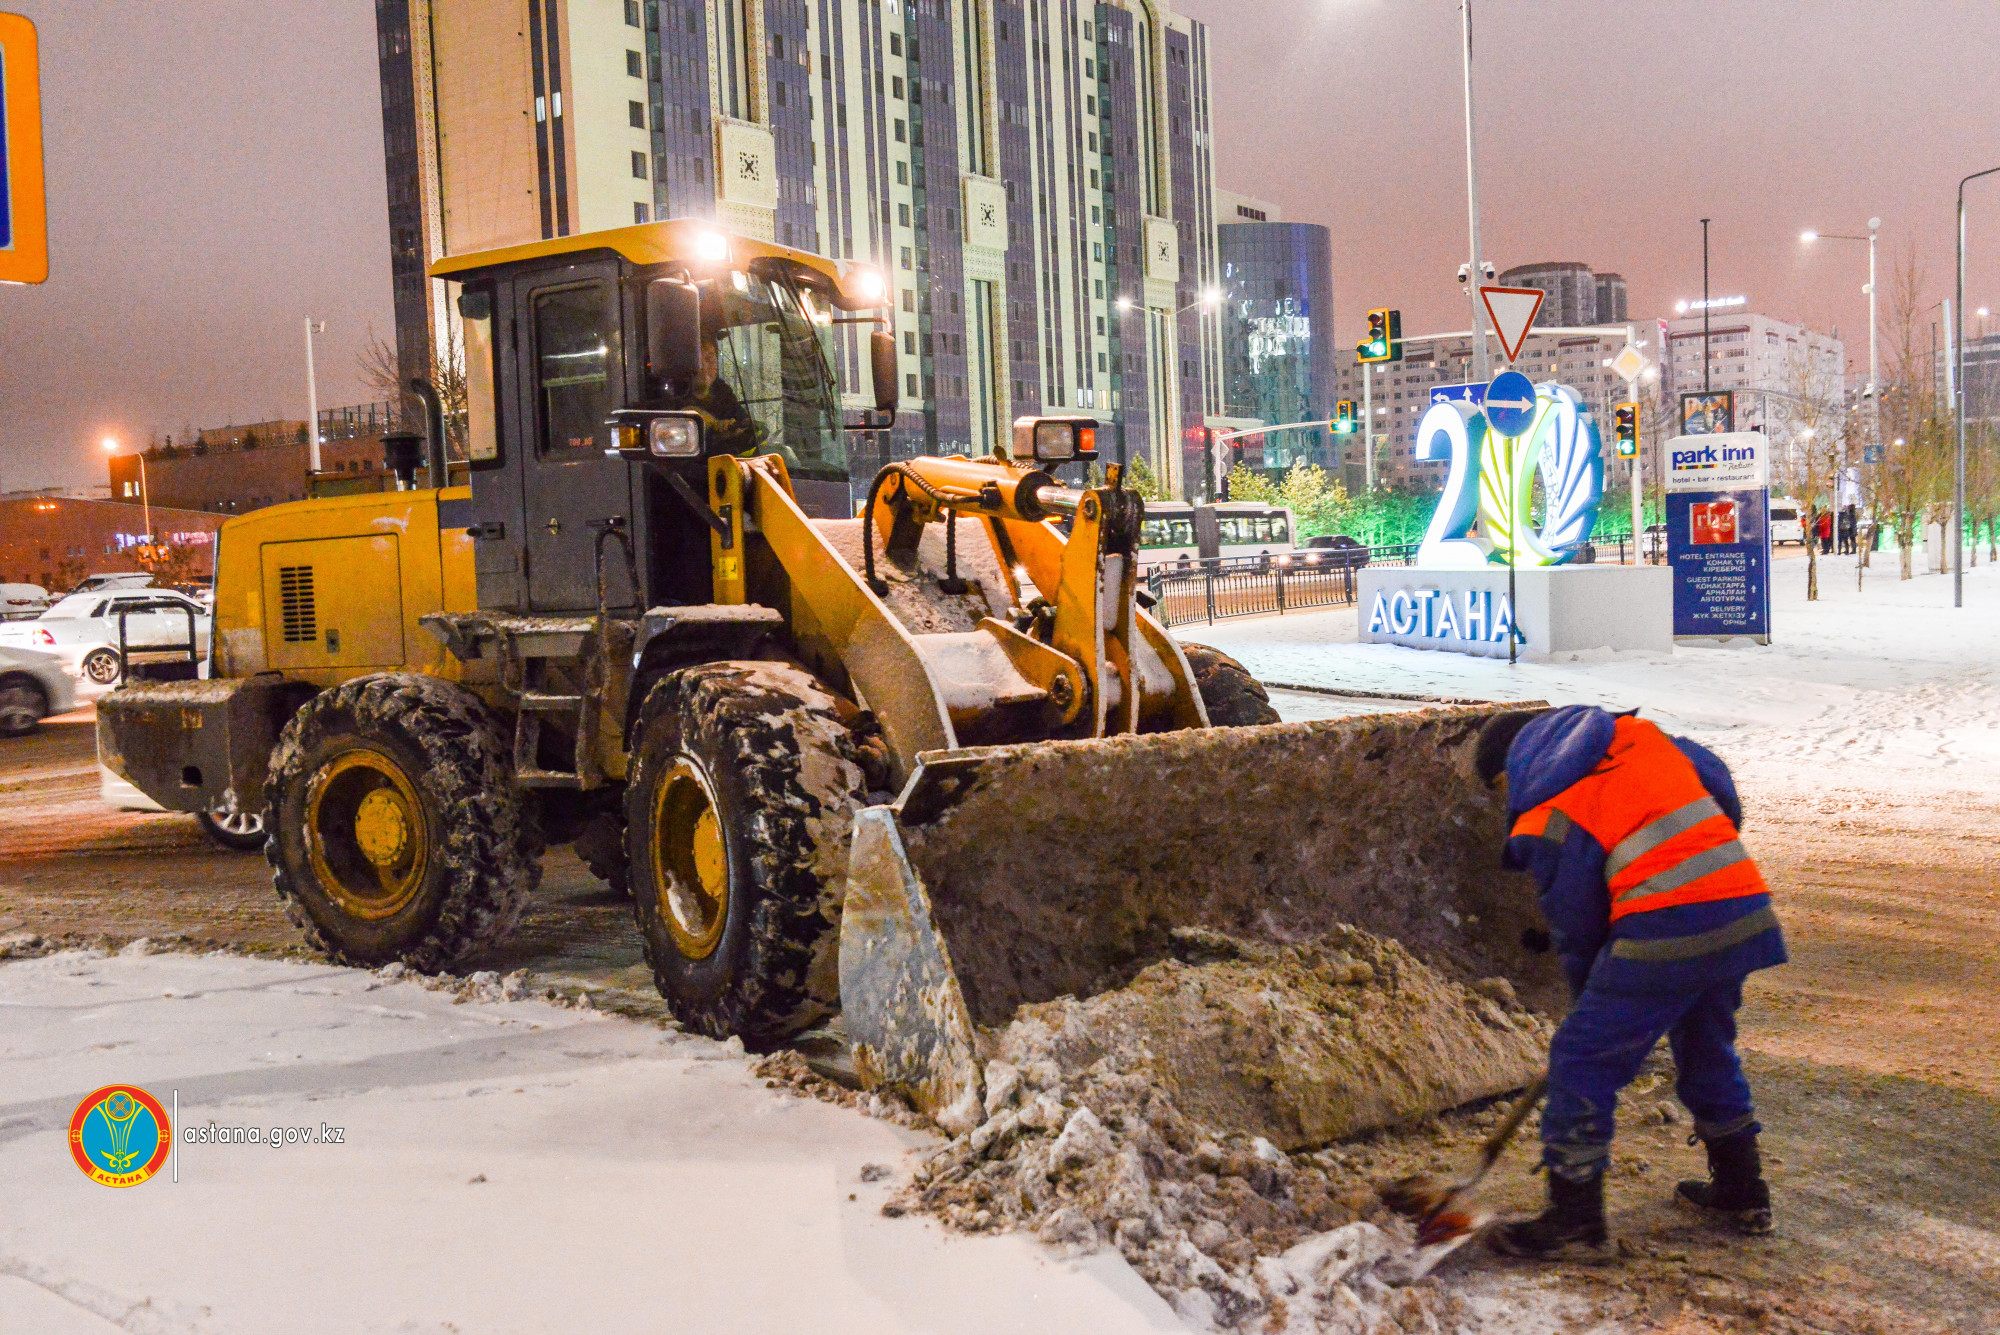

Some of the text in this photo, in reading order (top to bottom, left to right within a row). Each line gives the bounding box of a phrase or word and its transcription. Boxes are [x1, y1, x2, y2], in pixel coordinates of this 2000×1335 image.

[1672, 444, 1755, 470] park inn
[1672, 476, 1690, 484] hotel
[1717, 473, 1755, 481] restaurant
[1367, 588, 1526, 644] АСТАНА
